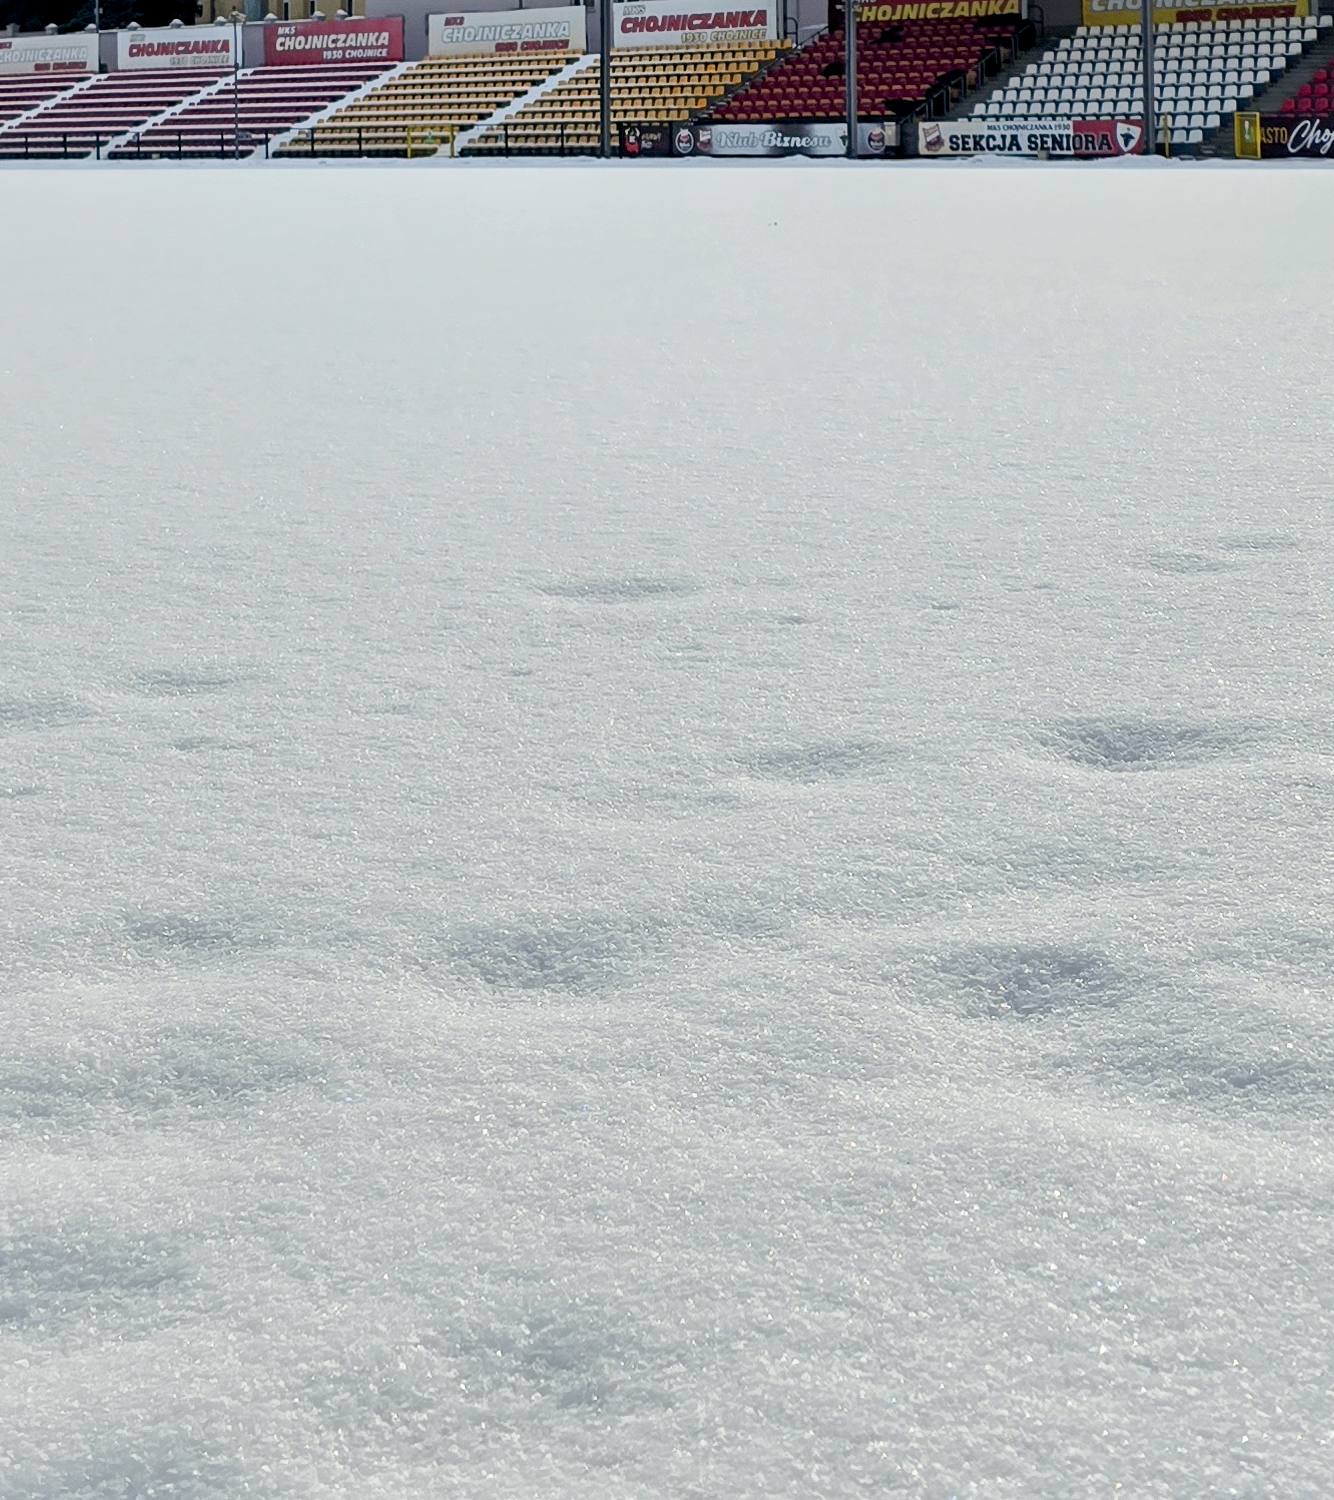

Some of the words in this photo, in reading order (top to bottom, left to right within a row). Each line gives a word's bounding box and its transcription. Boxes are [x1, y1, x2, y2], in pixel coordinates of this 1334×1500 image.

[278, 26, 296, 35] MKS
[620, 10, 767, 34] CHOJNICZANKA
[442, 21, 570, 43] CHOJNICZANKA
[681, 32, 707, 43] 1930
[710, 29, 767, 42] CHOJNICE
[129, 39, 230, 57] CHOJNICZANKA
[276, 32, 389, 51] CHOJNICZANKA
[323, 50, 342, 59] 1930
[345, 49, 388, 59] CHOJNICE
[717, 130, 758, 148] Klub
[761, 130, 832, 148] Biznesu
[949, 134, 1022, 151] SEKCJA
[1027, 133, 1113, 151] SENIORA
